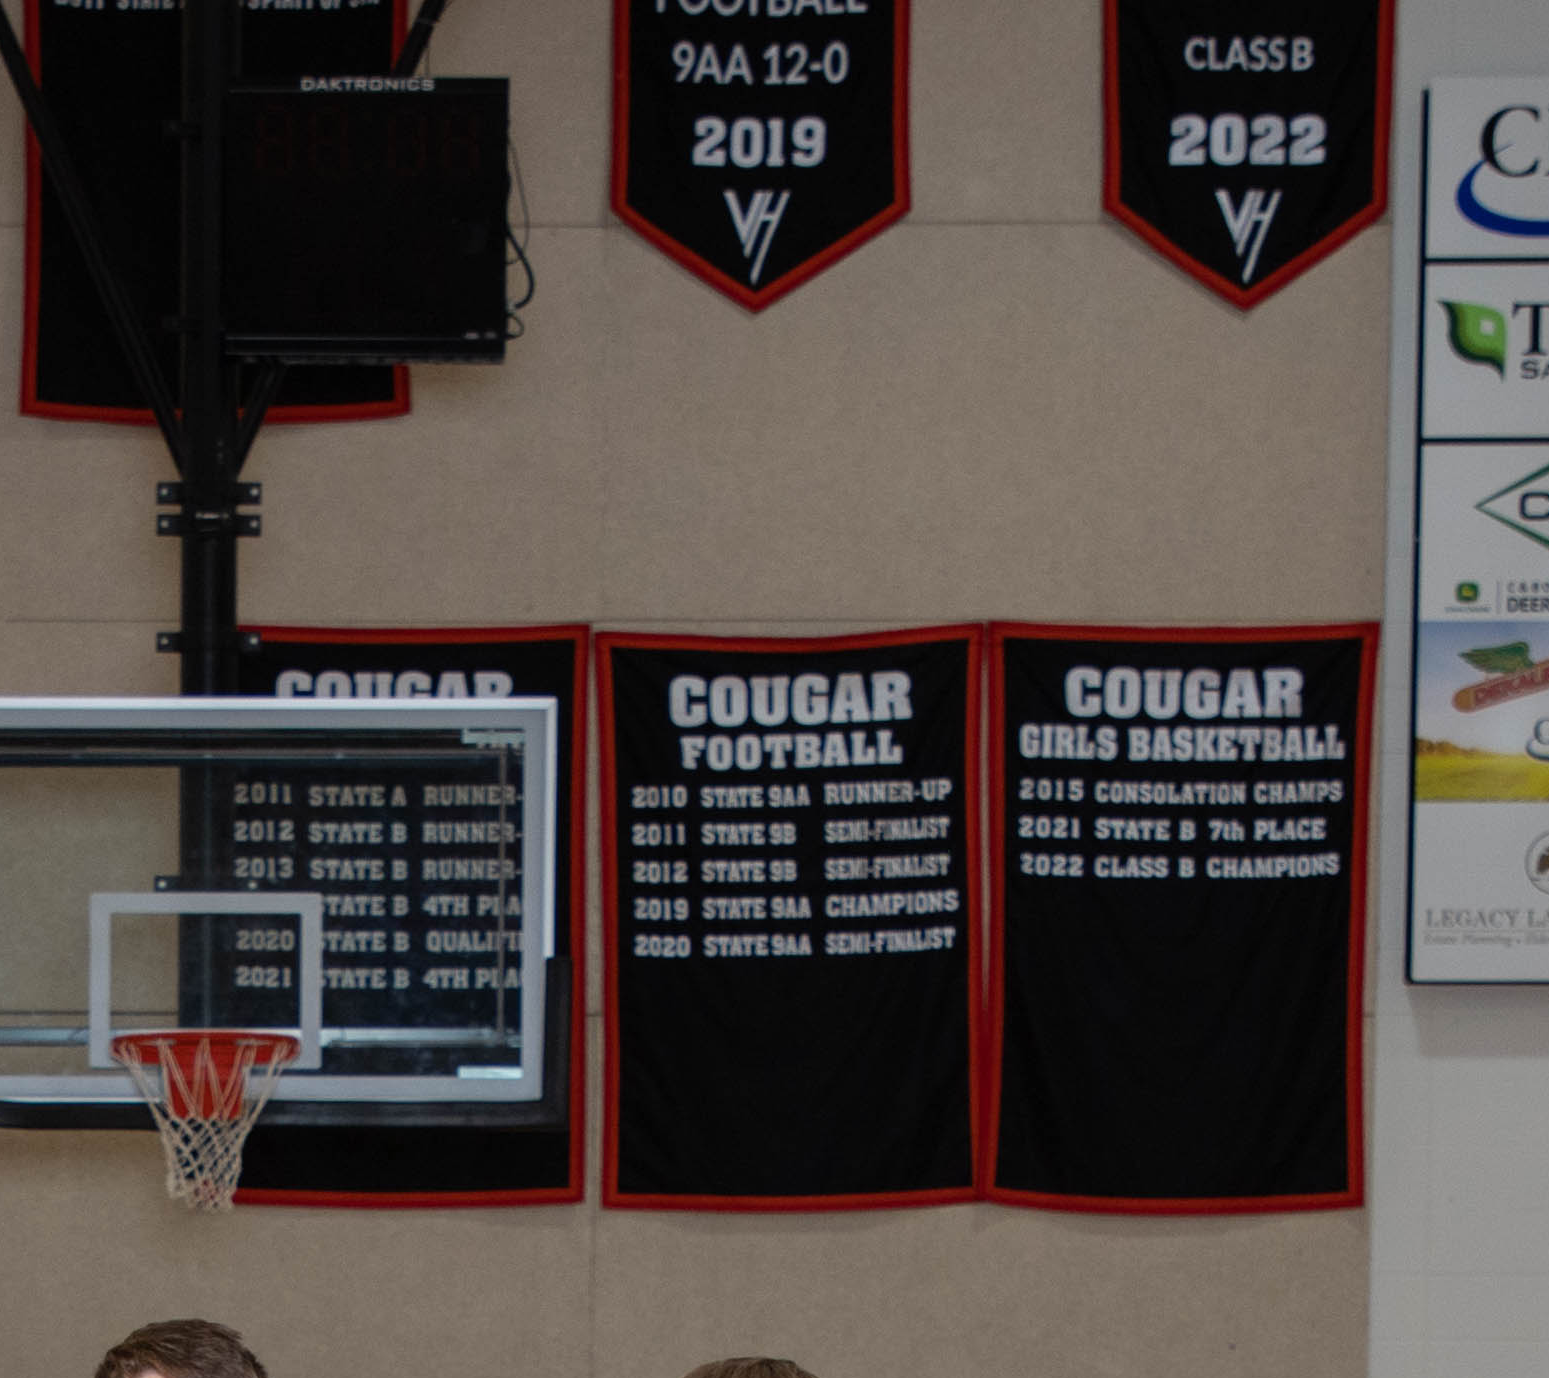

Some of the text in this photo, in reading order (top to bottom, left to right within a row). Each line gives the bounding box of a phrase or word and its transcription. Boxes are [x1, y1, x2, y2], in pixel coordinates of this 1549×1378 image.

[672, 41, 849, 86] 9AA 12-0
[1184, 36, 1315, 72] CLASS B
[300, 78, 435, 92] DAKTRONICS
[691, 116, 827, 169] 2019
[1167, 114, 1328, 167] 2022
[669, 670, 913, 727] COUGAR
[1064, 666, 1303, 719] COUGAR
[680, 729, 903, 771] FOOTBALL
[1019, 723, 1345, 762] GIRLS BASKETBALL
[233, 782, 292, 805] 2011
[308, 785, 385, 807] STATE
[391, 786, 407, 807] A
[631, 778, 952, 808] 2010 STATE 9AA RUNNER-UP
[1018, 778, 1343, 805] 2015 CONSOLATION CHAMPS
[233, 820, 295, 842] 2012
[308, 822, 383, 844] STATE
[391, 822, 407, 844] B
[631, 816, 950, 846] 2011 STATE 9B SEMI-FINALIST
[1018, 816, 1327, 841] 2021 STATE B 7th PLACE
[233, 857, 294, 879] 2013
[309, 859, 384, 881] STATE
[392, 859, 408, 881] B
[633, 854, 950, 883] 2012 STATE 9B SEMI-FINALIST
[1020, 852, 1340, 879] 2022 CLASS B CHAMPIONS
[392, 896, 469, 916] B 4TH
[634, 890, 960, 921] 2019 STATE 9AA CHAMPIONS
[1426, 908, 1520, 929] LEGACY
[236, 929, 409, 952] 2020 B
[634, 927, 956, 958] 2020 STATE 9AA SEMI-FINALIST
[236, 966, 470, 989] 2021 B 4TH
